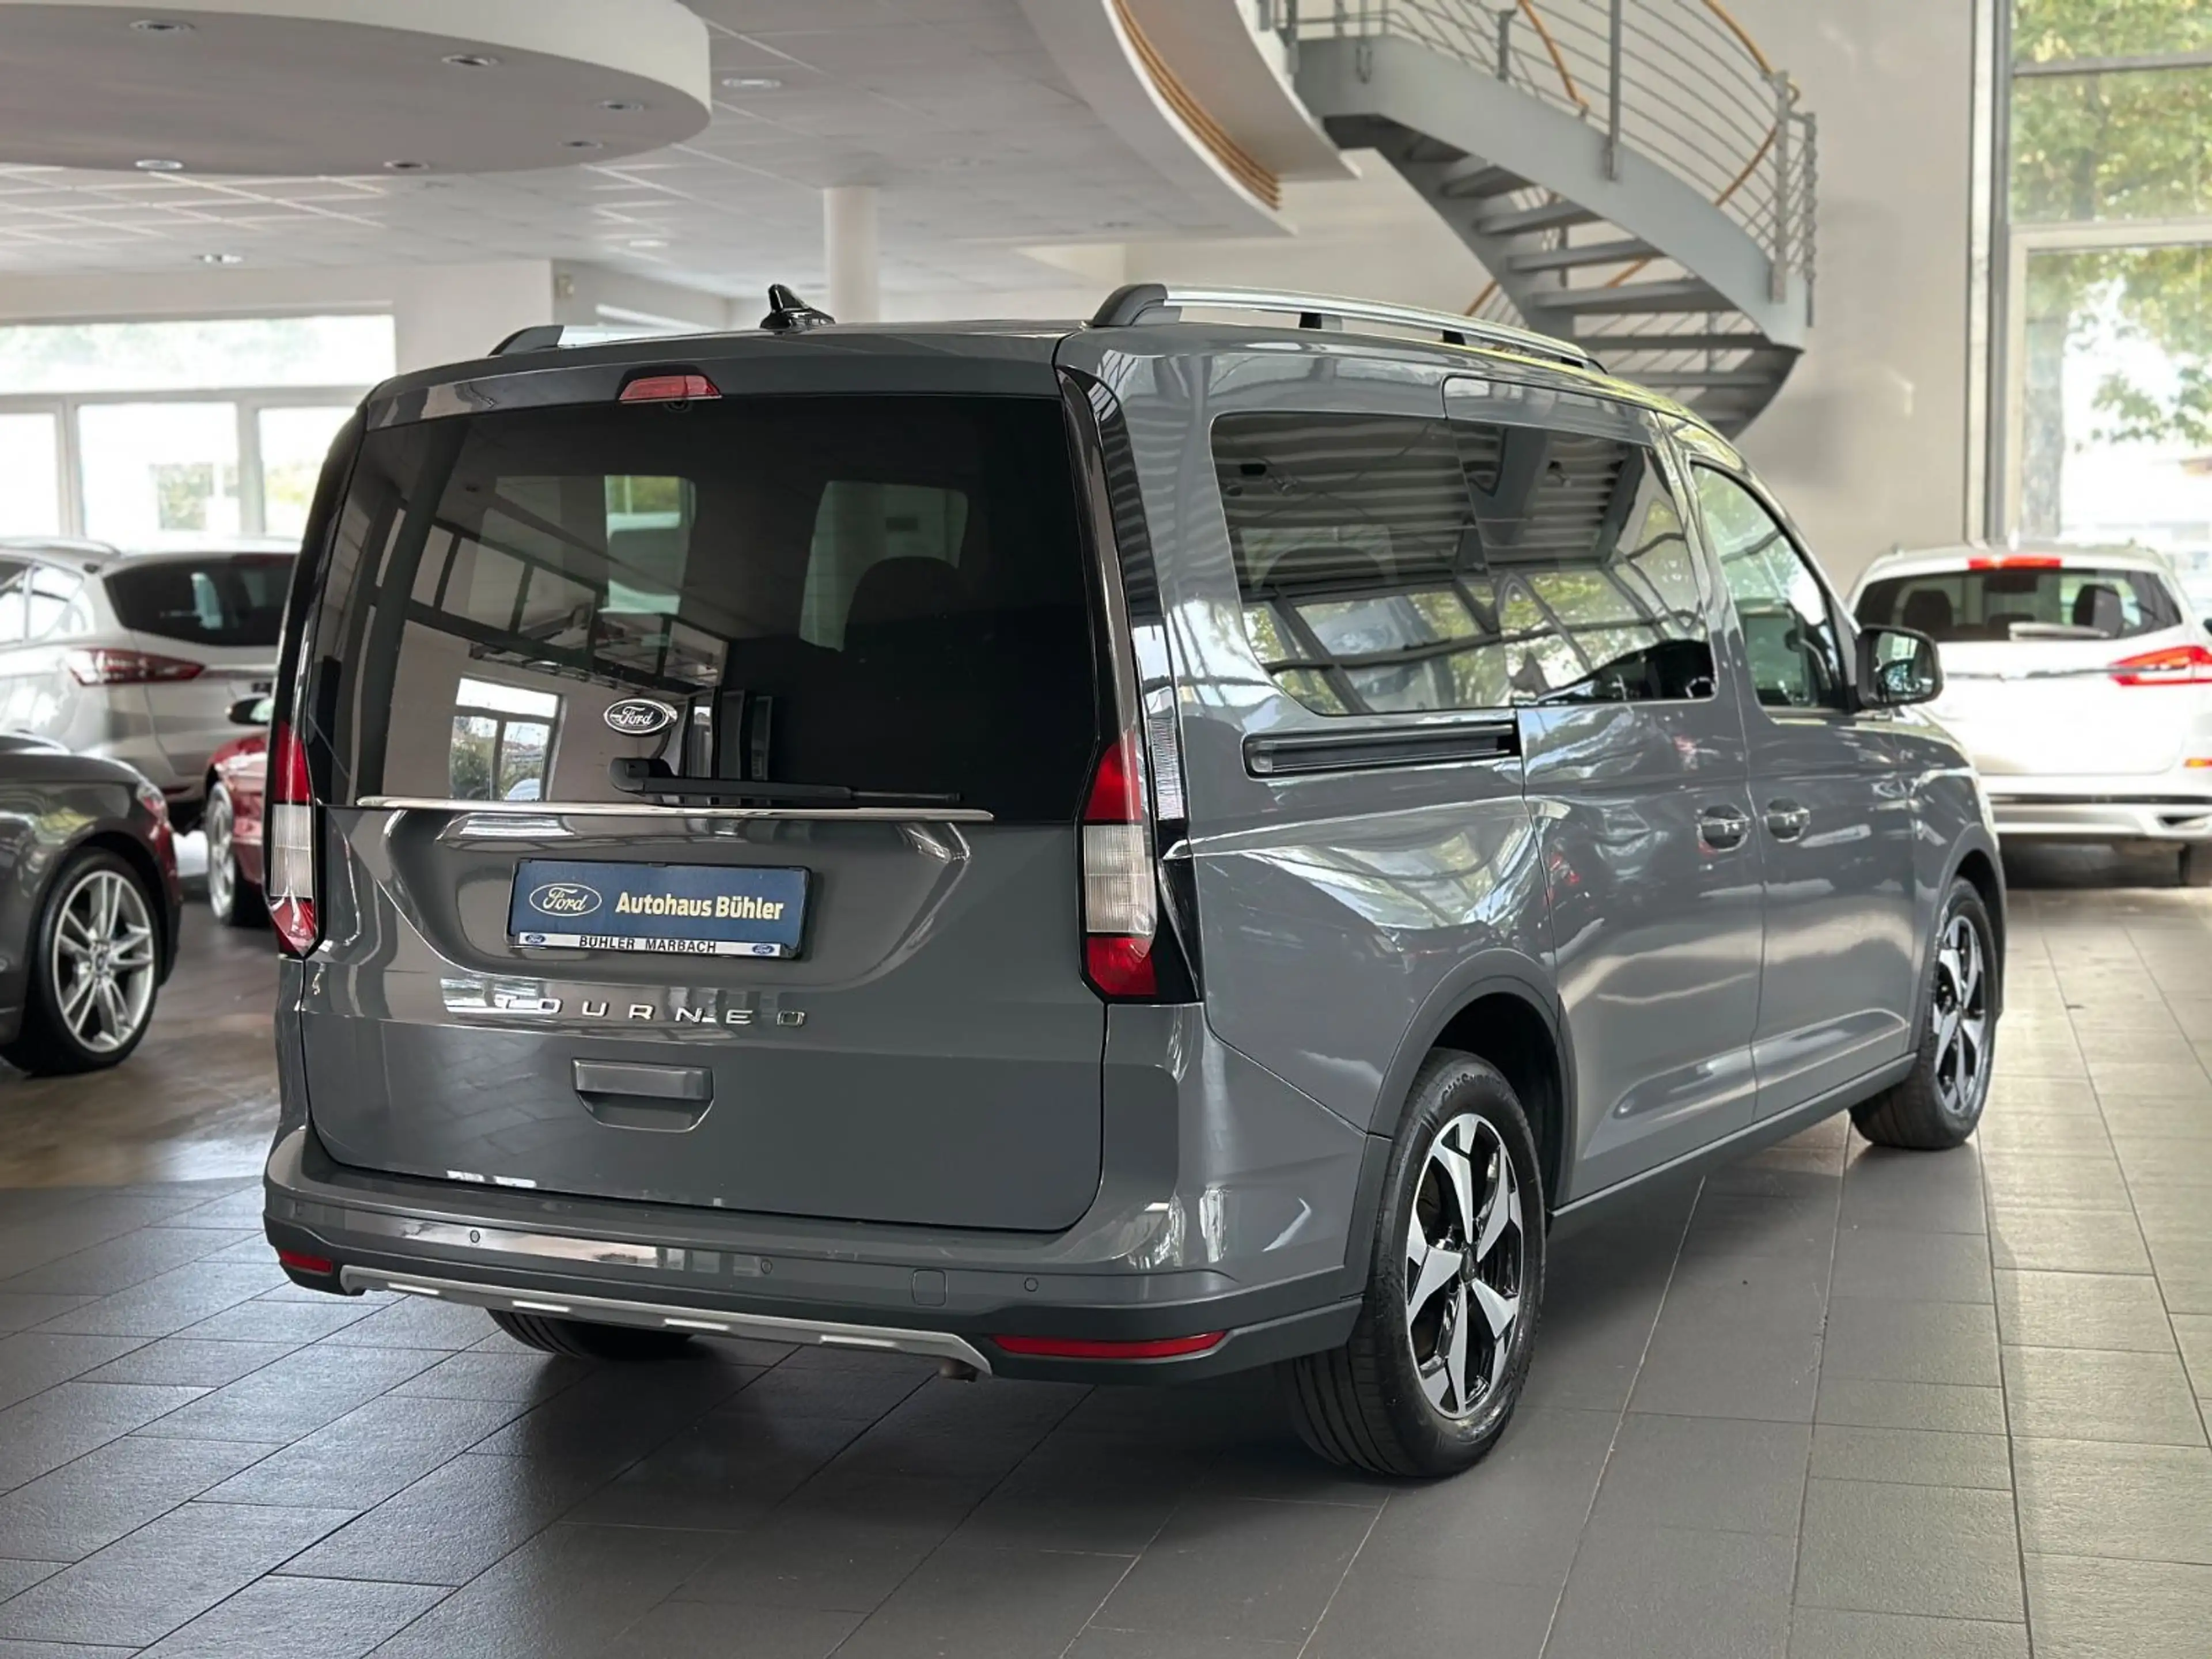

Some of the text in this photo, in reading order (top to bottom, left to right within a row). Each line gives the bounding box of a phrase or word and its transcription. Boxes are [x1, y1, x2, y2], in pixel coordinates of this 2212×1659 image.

[618, 706, 654, 725] Ford
[543, 887, 587, 911] Ford
[615, 892, 784, 920] Autohaus Bühler
[645, 940, 716, 953] MARBACH
[494, 994, 805, 1025] TOURNEO
